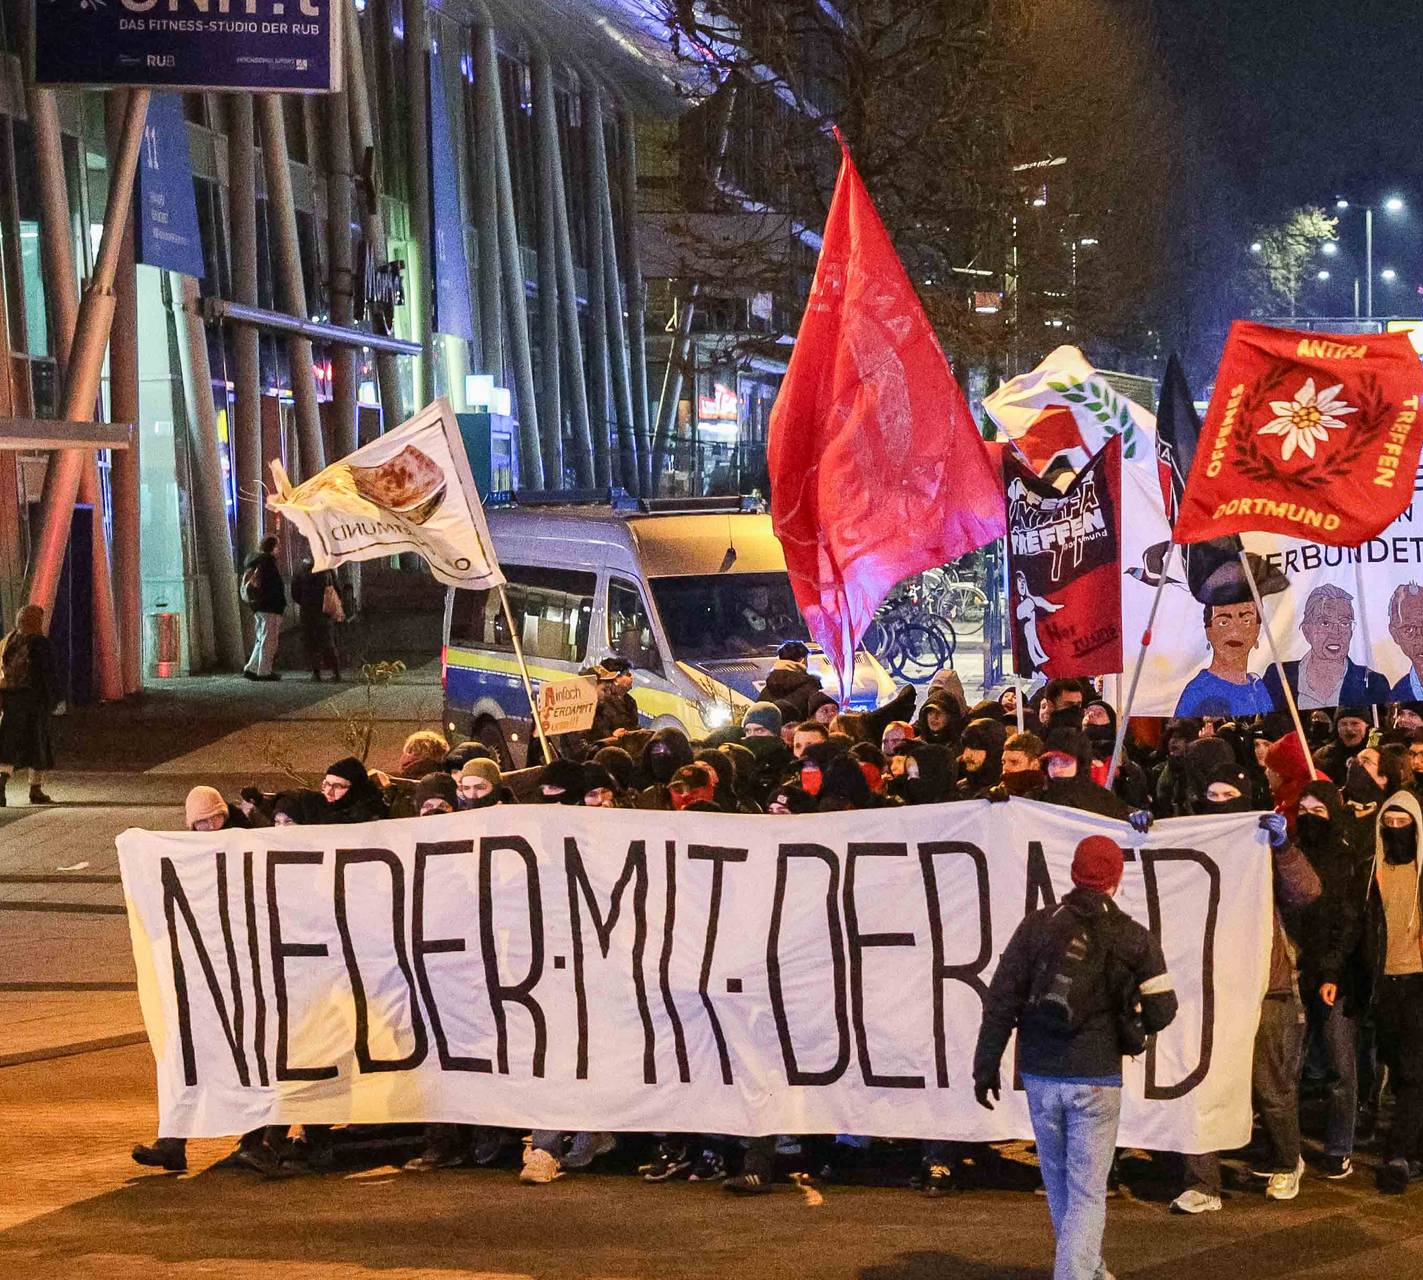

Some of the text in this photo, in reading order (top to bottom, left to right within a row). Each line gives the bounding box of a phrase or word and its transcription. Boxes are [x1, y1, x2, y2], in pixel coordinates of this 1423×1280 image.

[119, 19, 320, 35] DAS FITNESS-STUDIO DER RUB
[146, 54, 176, 67] RUB
[1297, 339, 1368, 359] ANTIFA
[1373, 395, 1419, 488] TREFFEN
[1212, 497, 1342, 531] DORTMUND
[1011, 507, 1106, 556] TREFFEN
